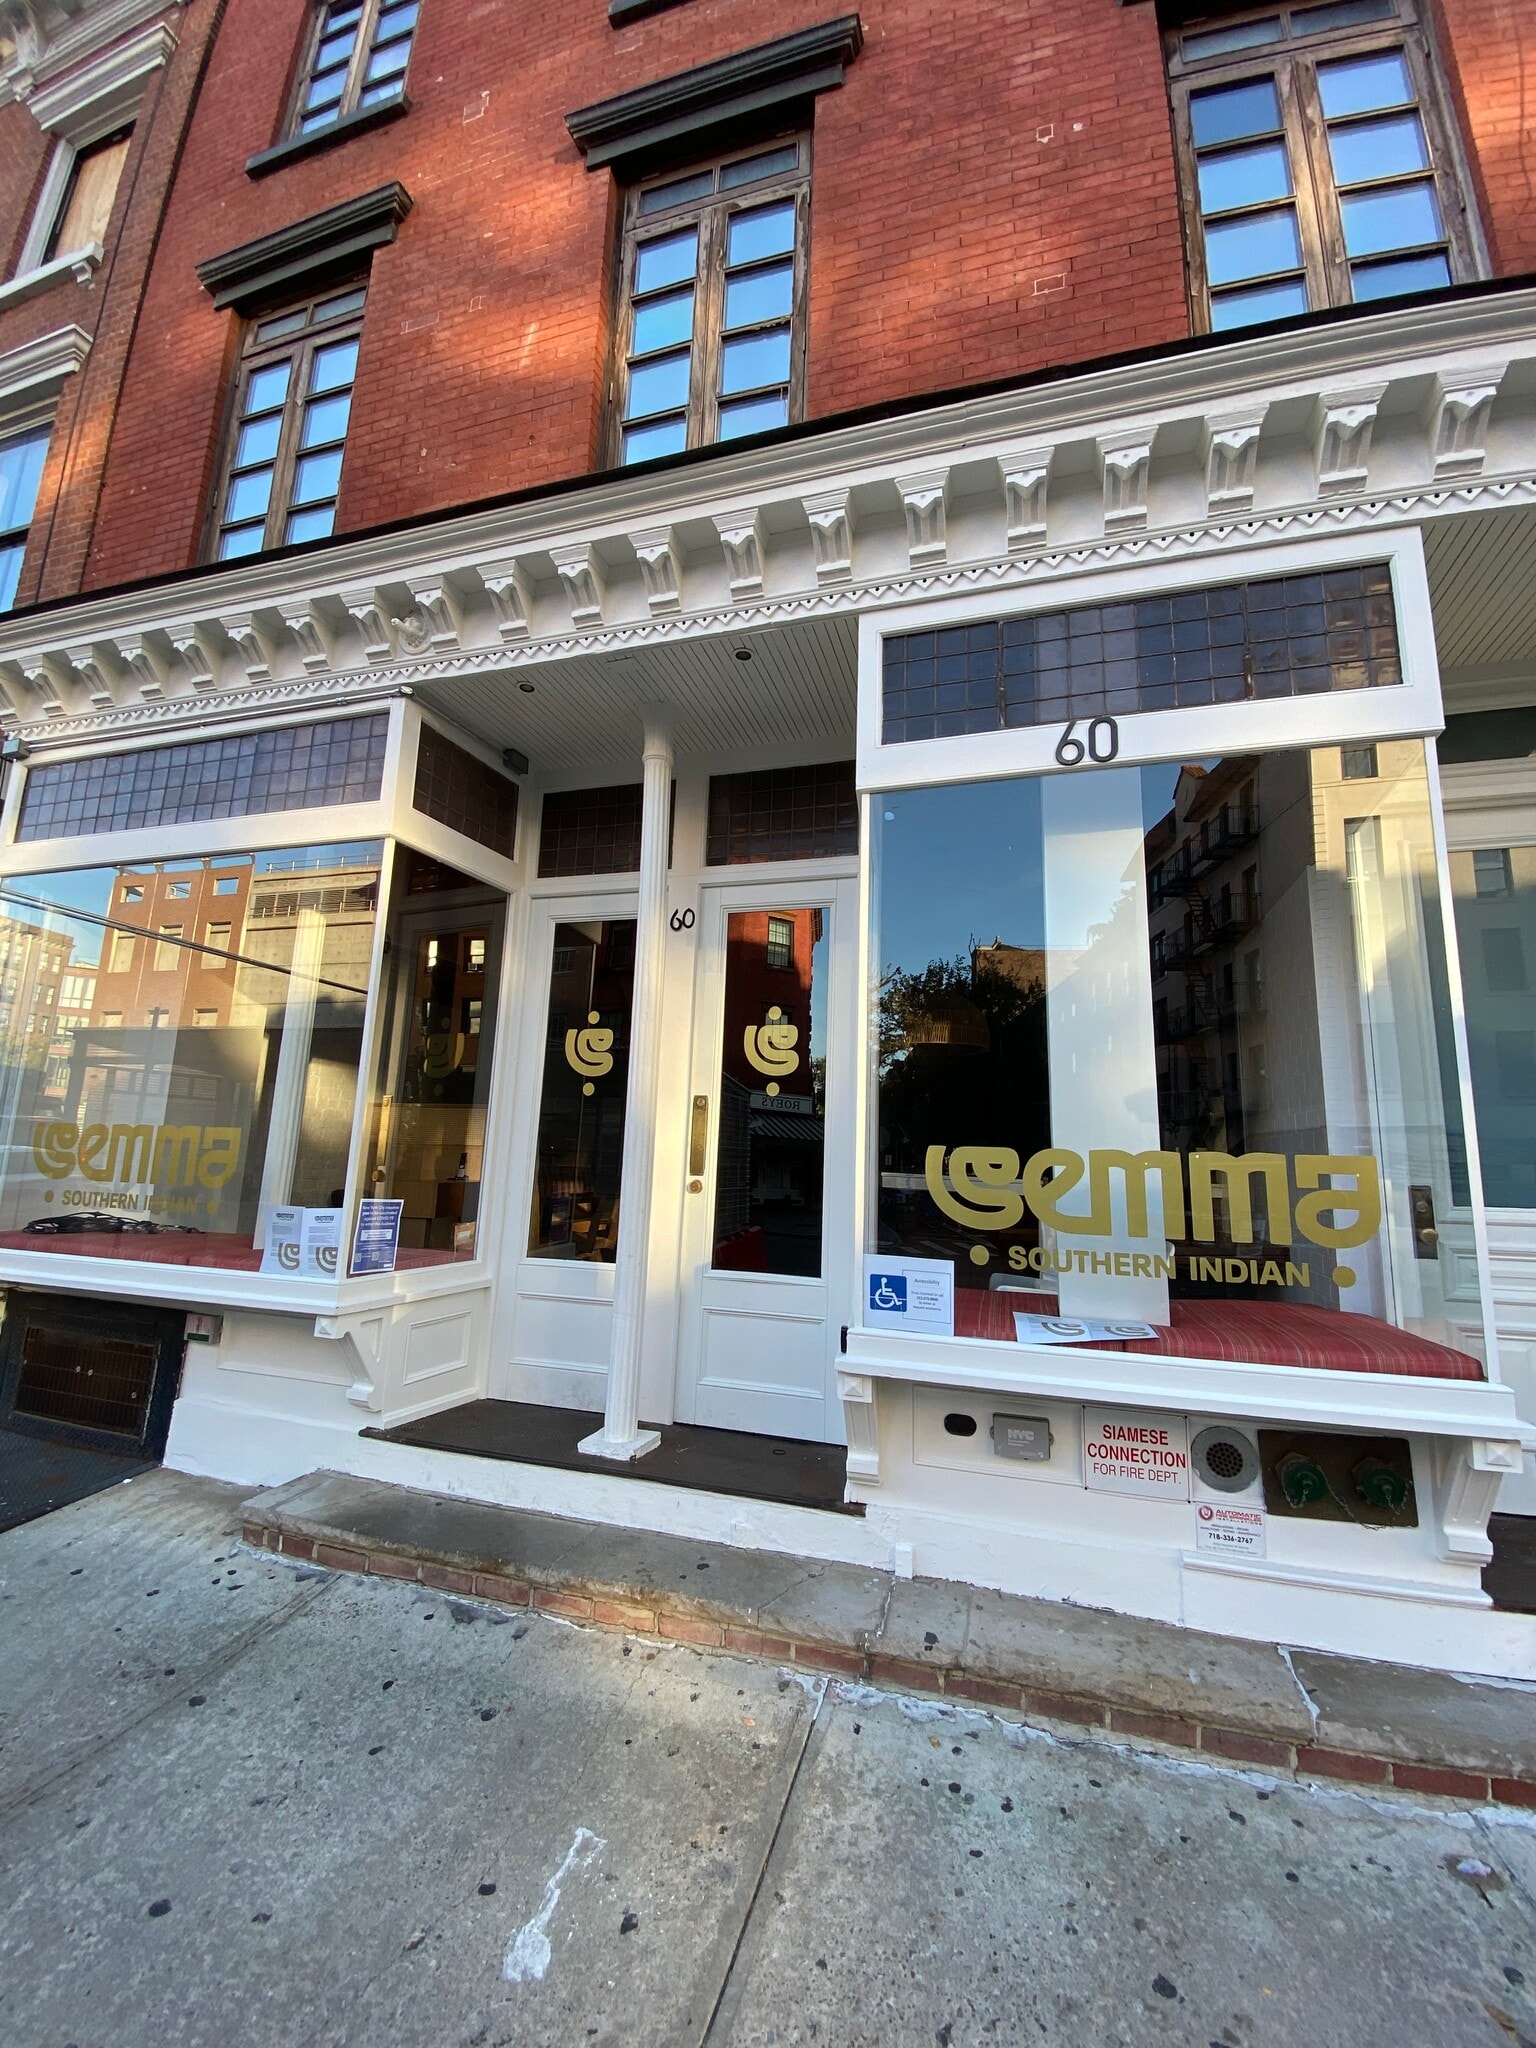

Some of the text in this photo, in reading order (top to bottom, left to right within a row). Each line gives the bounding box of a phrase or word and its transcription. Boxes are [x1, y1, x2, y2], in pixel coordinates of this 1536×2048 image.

[1055, 716, 1119, 766] 60
[670, 908, 696, 932] 60
[62, 1189, 198, 1213] SOUTHERN INDIAN
[1008, 1245, 1310, 1288] SOUTHERN INDIAN
[1008, 1429, 1035, 1441] NYC
[1102, 1424, 1169, 1446] SIAMESE
[1087, 1442, 1186, 1468] CONNECTION
[1093, 1462, 1182, 1485] FOR FIRE DEPT.
[1216, 1509, 1262, 1519] AUTOMATIC
[1208, 1532, 1254, 1544] 718-336-2767
